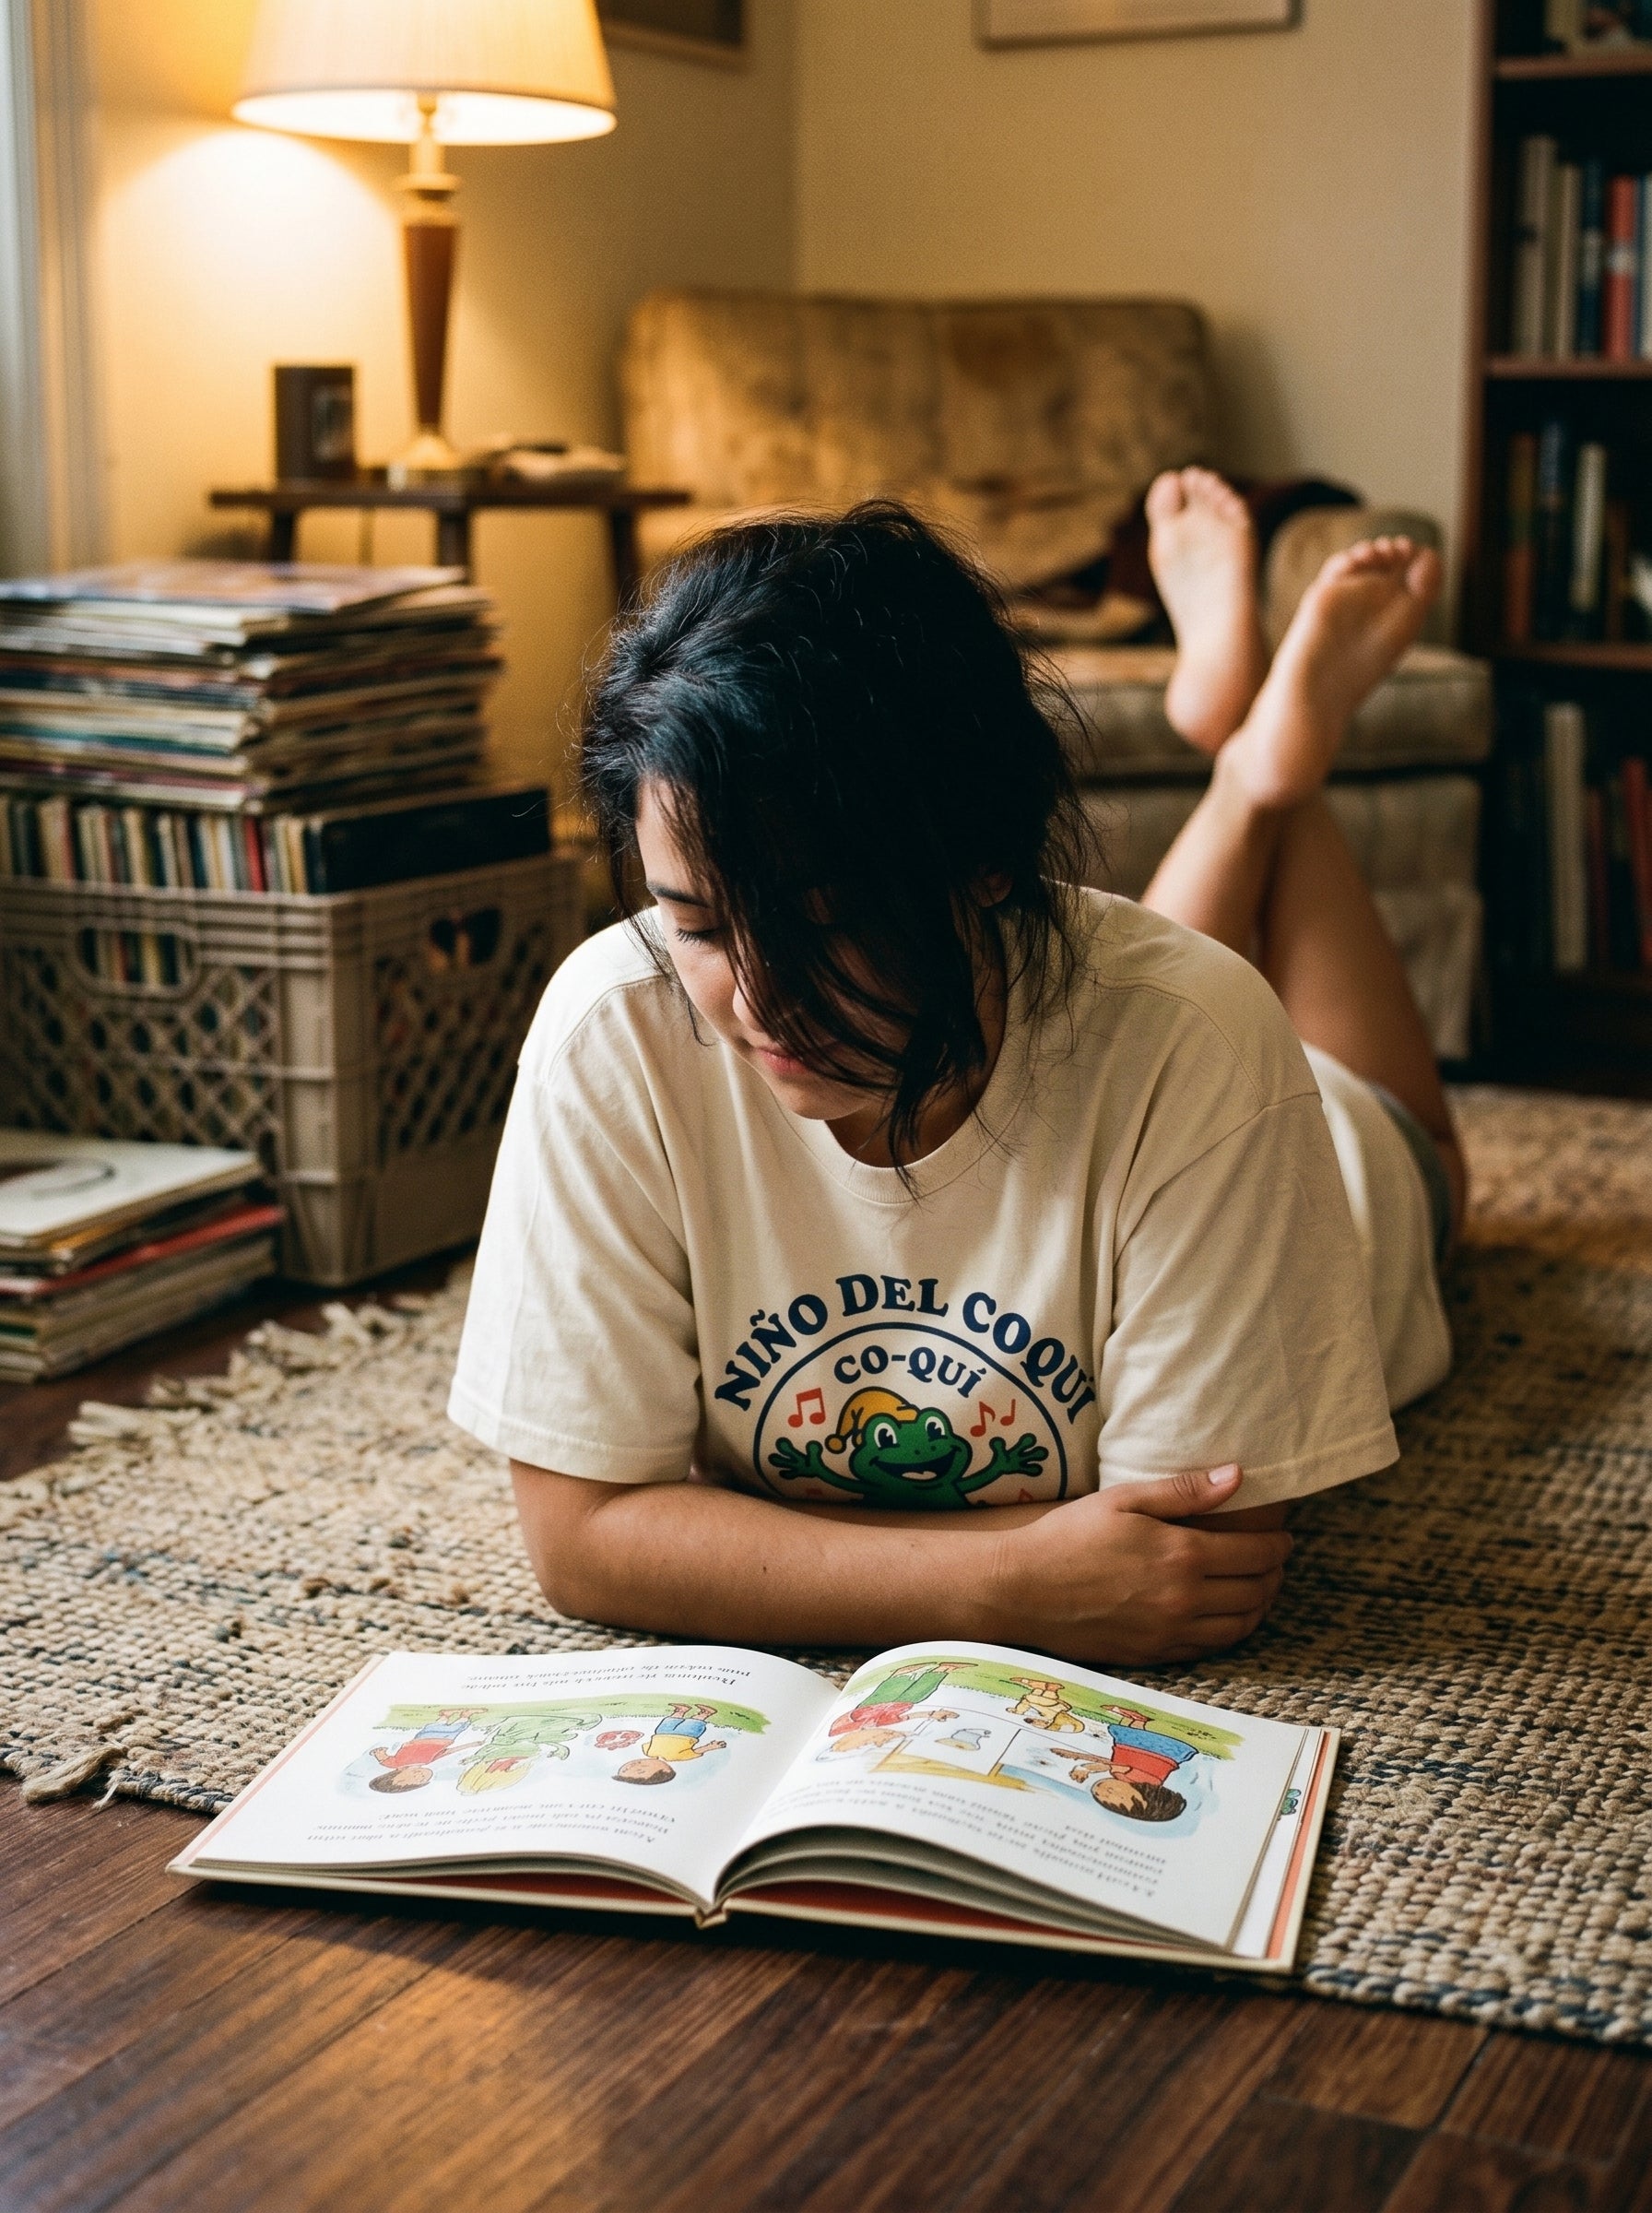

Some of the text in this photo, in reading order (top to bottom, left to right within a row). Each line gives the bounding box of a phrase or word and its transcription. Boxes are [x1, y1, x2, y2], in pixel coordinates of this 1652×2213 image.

[714, 1294, 828, 1411] NIÑO
[835, 1273, 949, 1317] DEL
[833, 1345, 986, 1399] CO-QUÍ
